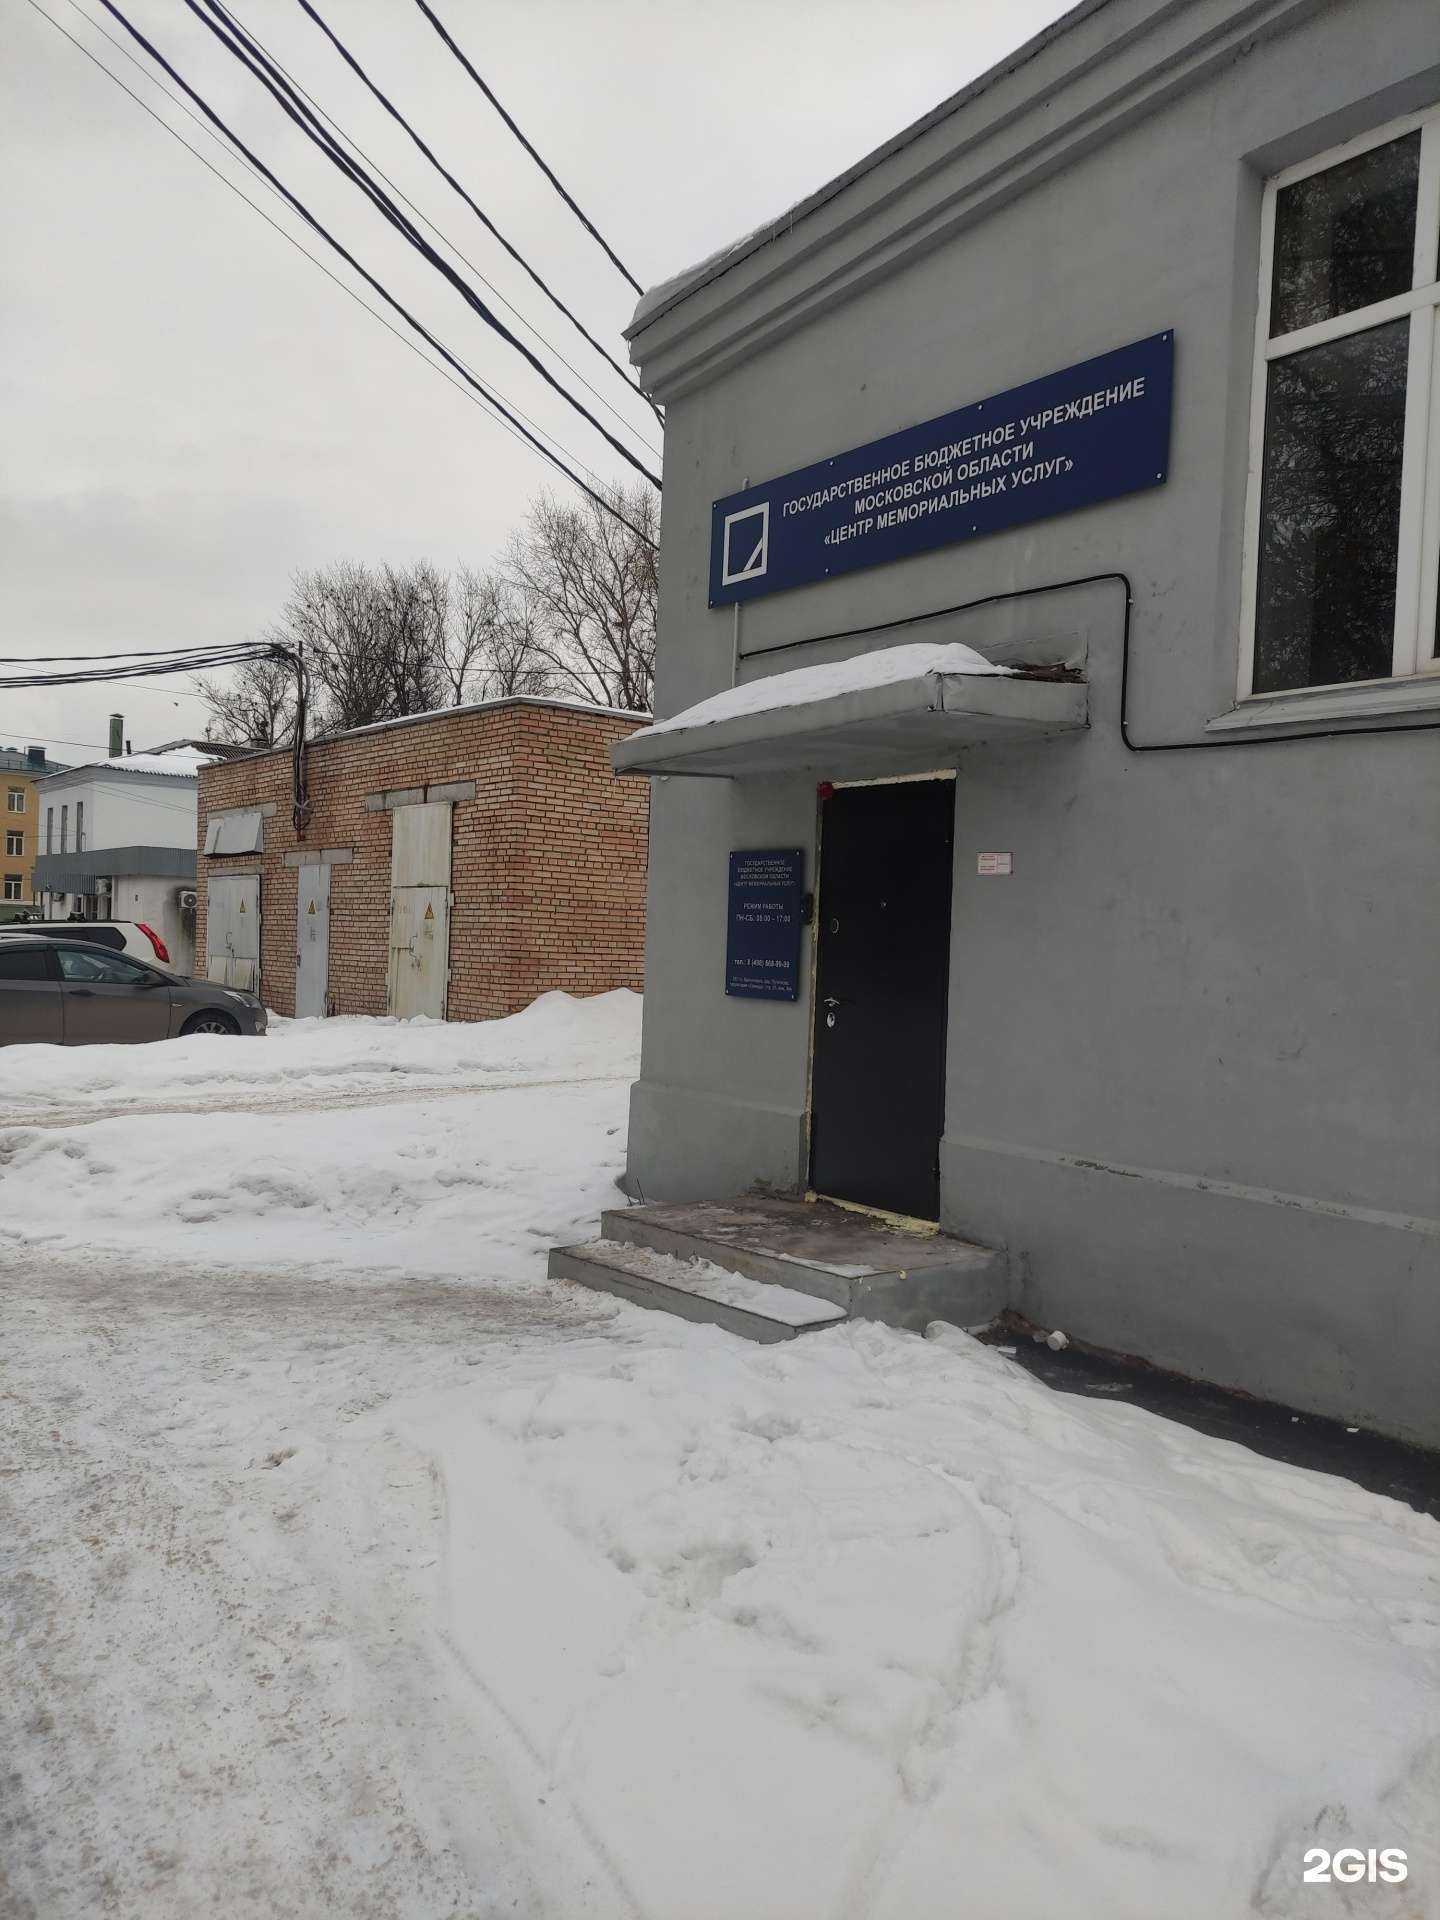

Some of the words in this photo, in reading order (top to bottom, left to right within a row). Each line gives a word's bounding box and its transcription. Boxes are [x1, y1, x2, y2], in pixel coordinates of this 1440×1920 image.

[782, 460, 911, 517] ГОСУДАРСТВЕННОЕ
[914, 422, 1016, 474] БЮДЖЕТНОЕ
[1019, 376, 1146, 436] УЧРЕЖДЕНИЕ
[854, 464, 953, 515] МОСКОВСКОЙ
[956, 441, 1034, 482] ОБЛАСТИ
[823, 517, 873, 546] «ЦЕНТР
[876, 476, 1006, 531] МЕМОРИАЛЬНЫХ
[1010, 456, 1074, 488] УСЛУГ»
